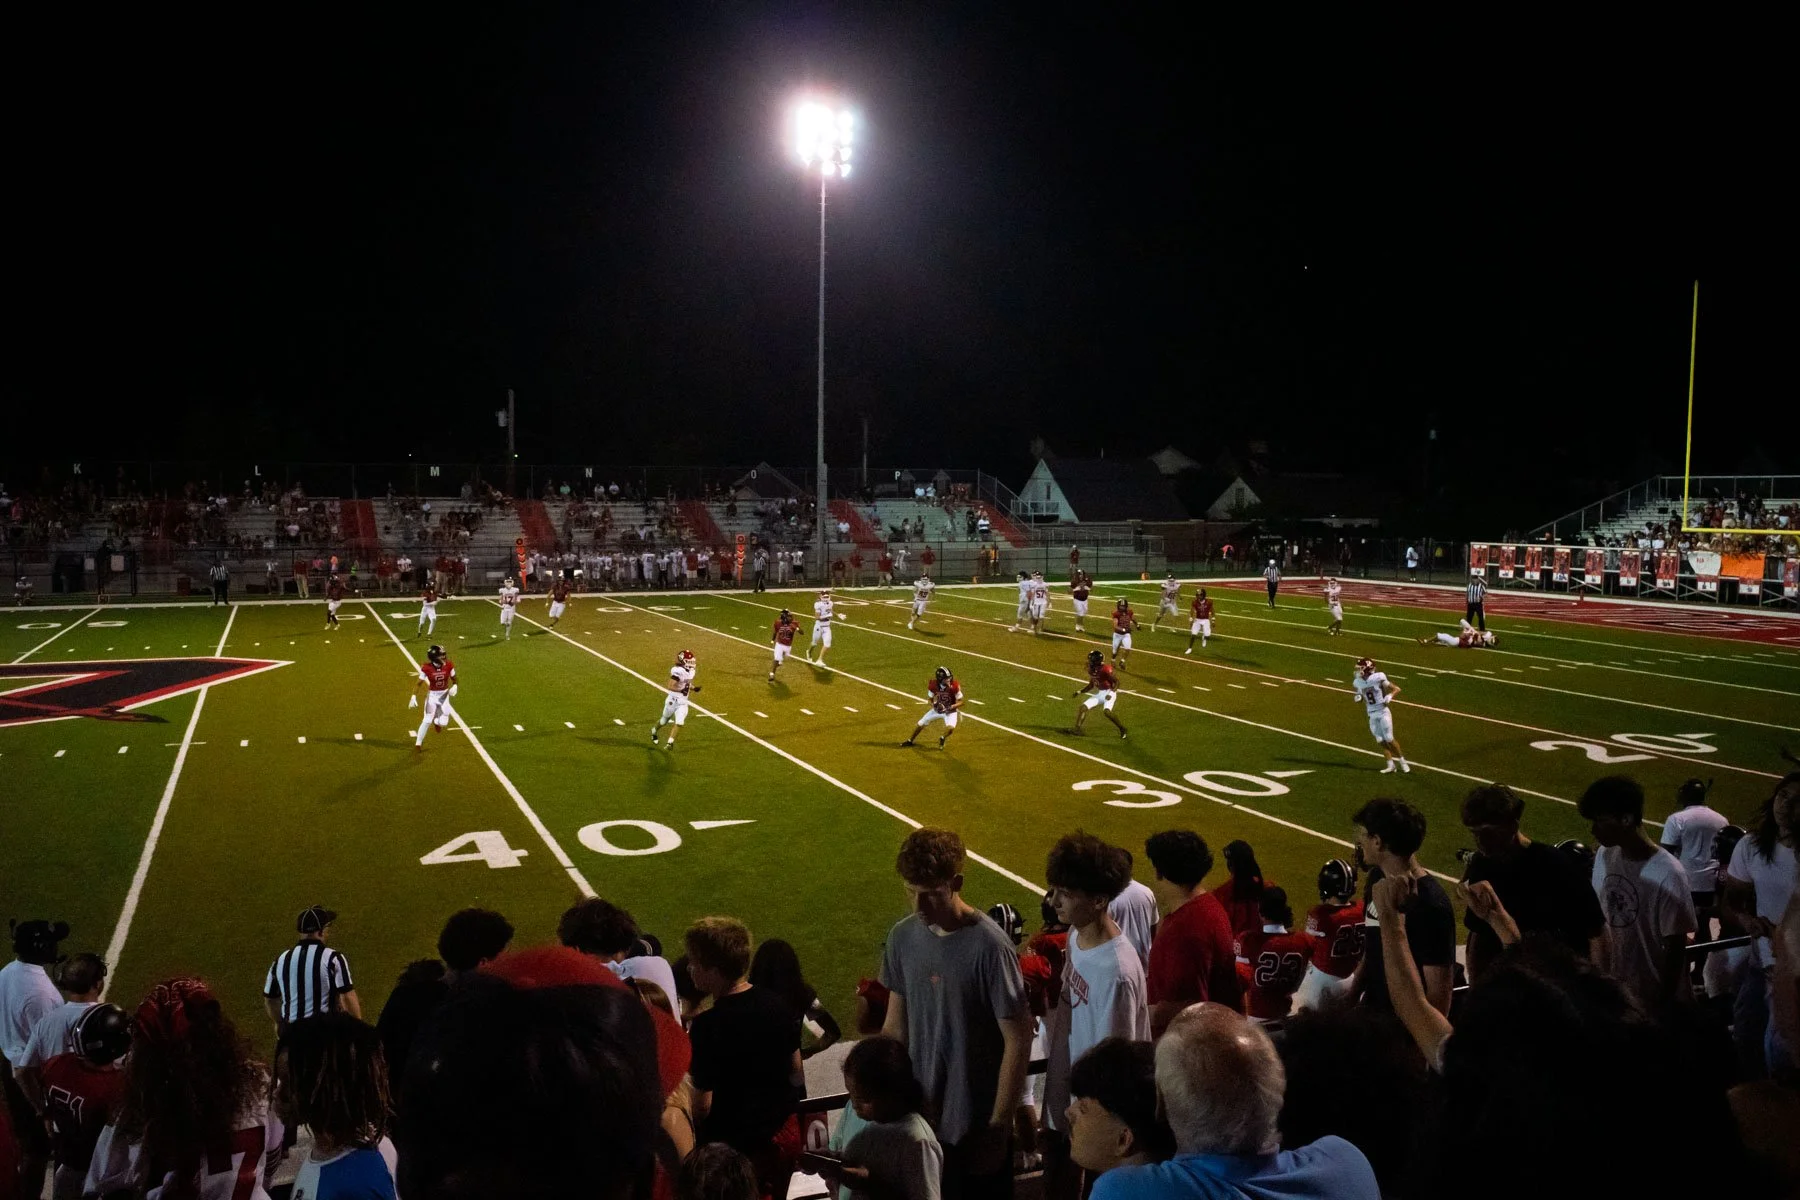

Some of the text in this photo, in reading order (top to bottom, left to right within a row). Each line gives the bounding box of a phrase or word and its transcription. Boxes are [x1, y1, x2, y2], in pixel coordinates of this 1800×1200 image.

[73, 463, 82, 475] K
[254, 465, 262, 476] L
[430, 466, 440, 477] M
[585, 467, 593, 478] N
[894, 470, 901, 481] P
[1036, 589, 1046, 599] 57
[1530, 733, 1718, 764] 20
[1072, 770, 1291, 808] 30
[419, 819, 682, 868] 40
[1255, 951, 1304, 987] 23
